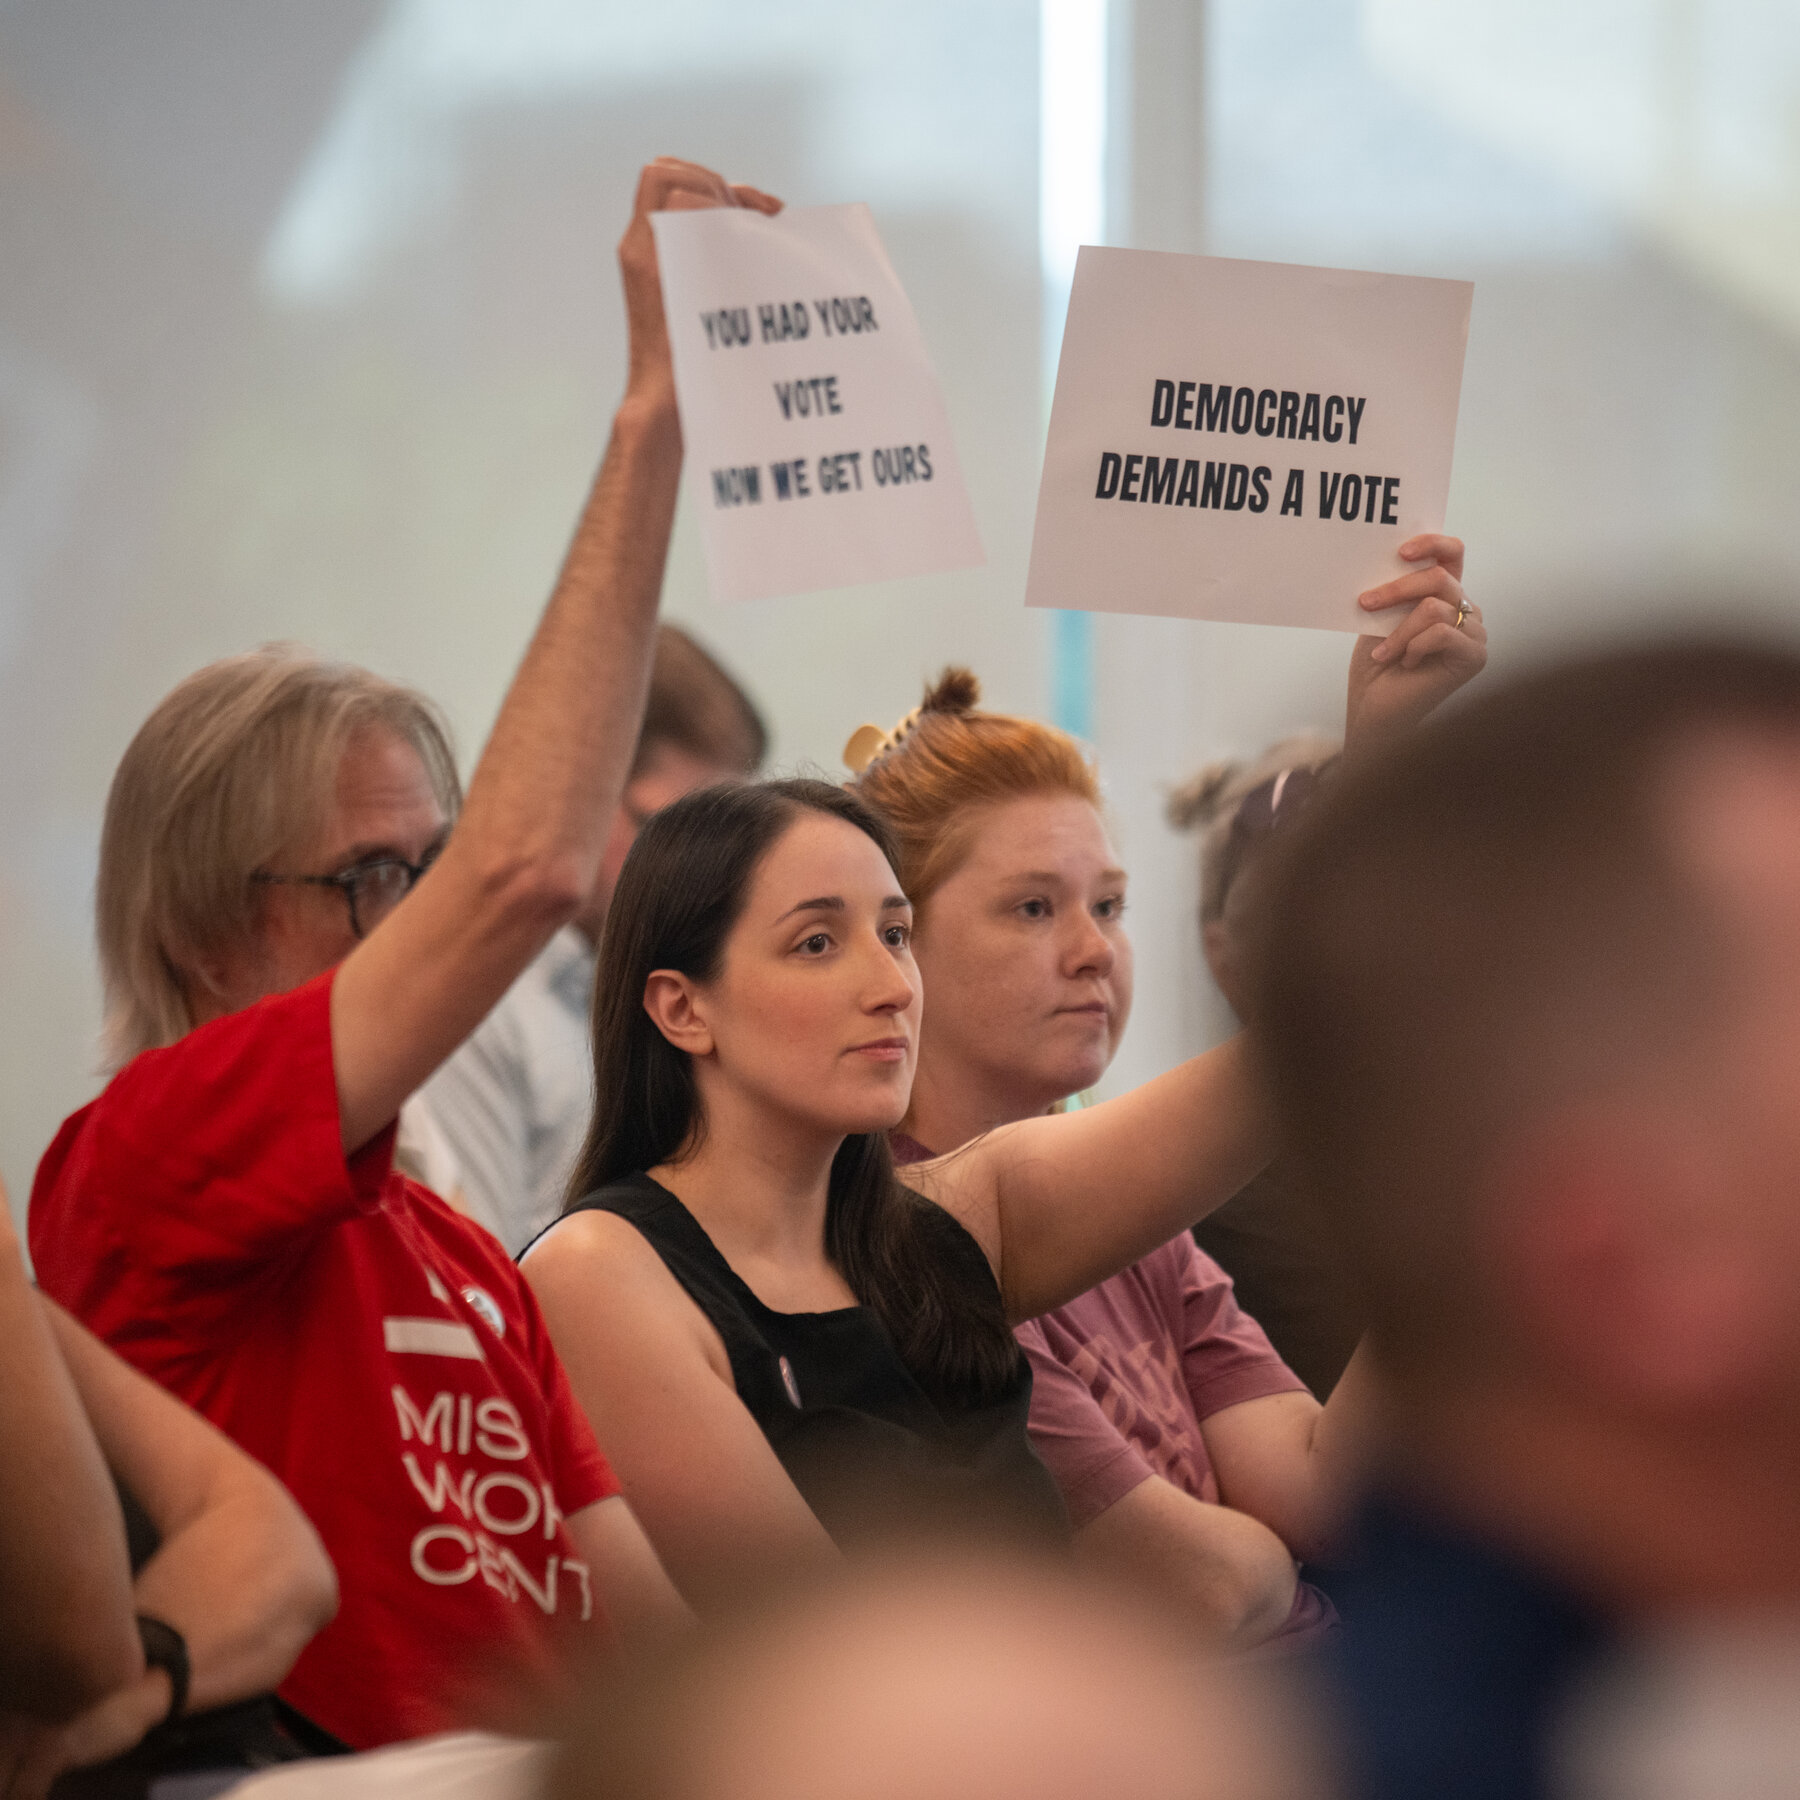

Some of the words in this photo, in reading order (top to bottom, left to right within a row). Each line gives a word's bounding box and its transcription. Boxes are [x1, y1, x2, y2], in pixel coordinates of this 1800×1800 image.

[701, 308, 752, 350] YOU
[758, 302, 811, 344] HAD
[814, 296, 879, 338] YOUR
[774, 375, 843, 421] VOTE
[1150, 379, 1367, 445] DEMOCRACY
[711, 465, 763, 509] NOW
[770, 459, 811, 502] WE
[818, 451, 863, 494] GET
[873, 444, 933, 488] OURS
[1095, 451, 1272, 514] DEMANDS
[1280, 468, 1304, 517] A
[1318, 471, 1401, 525] VOTE
